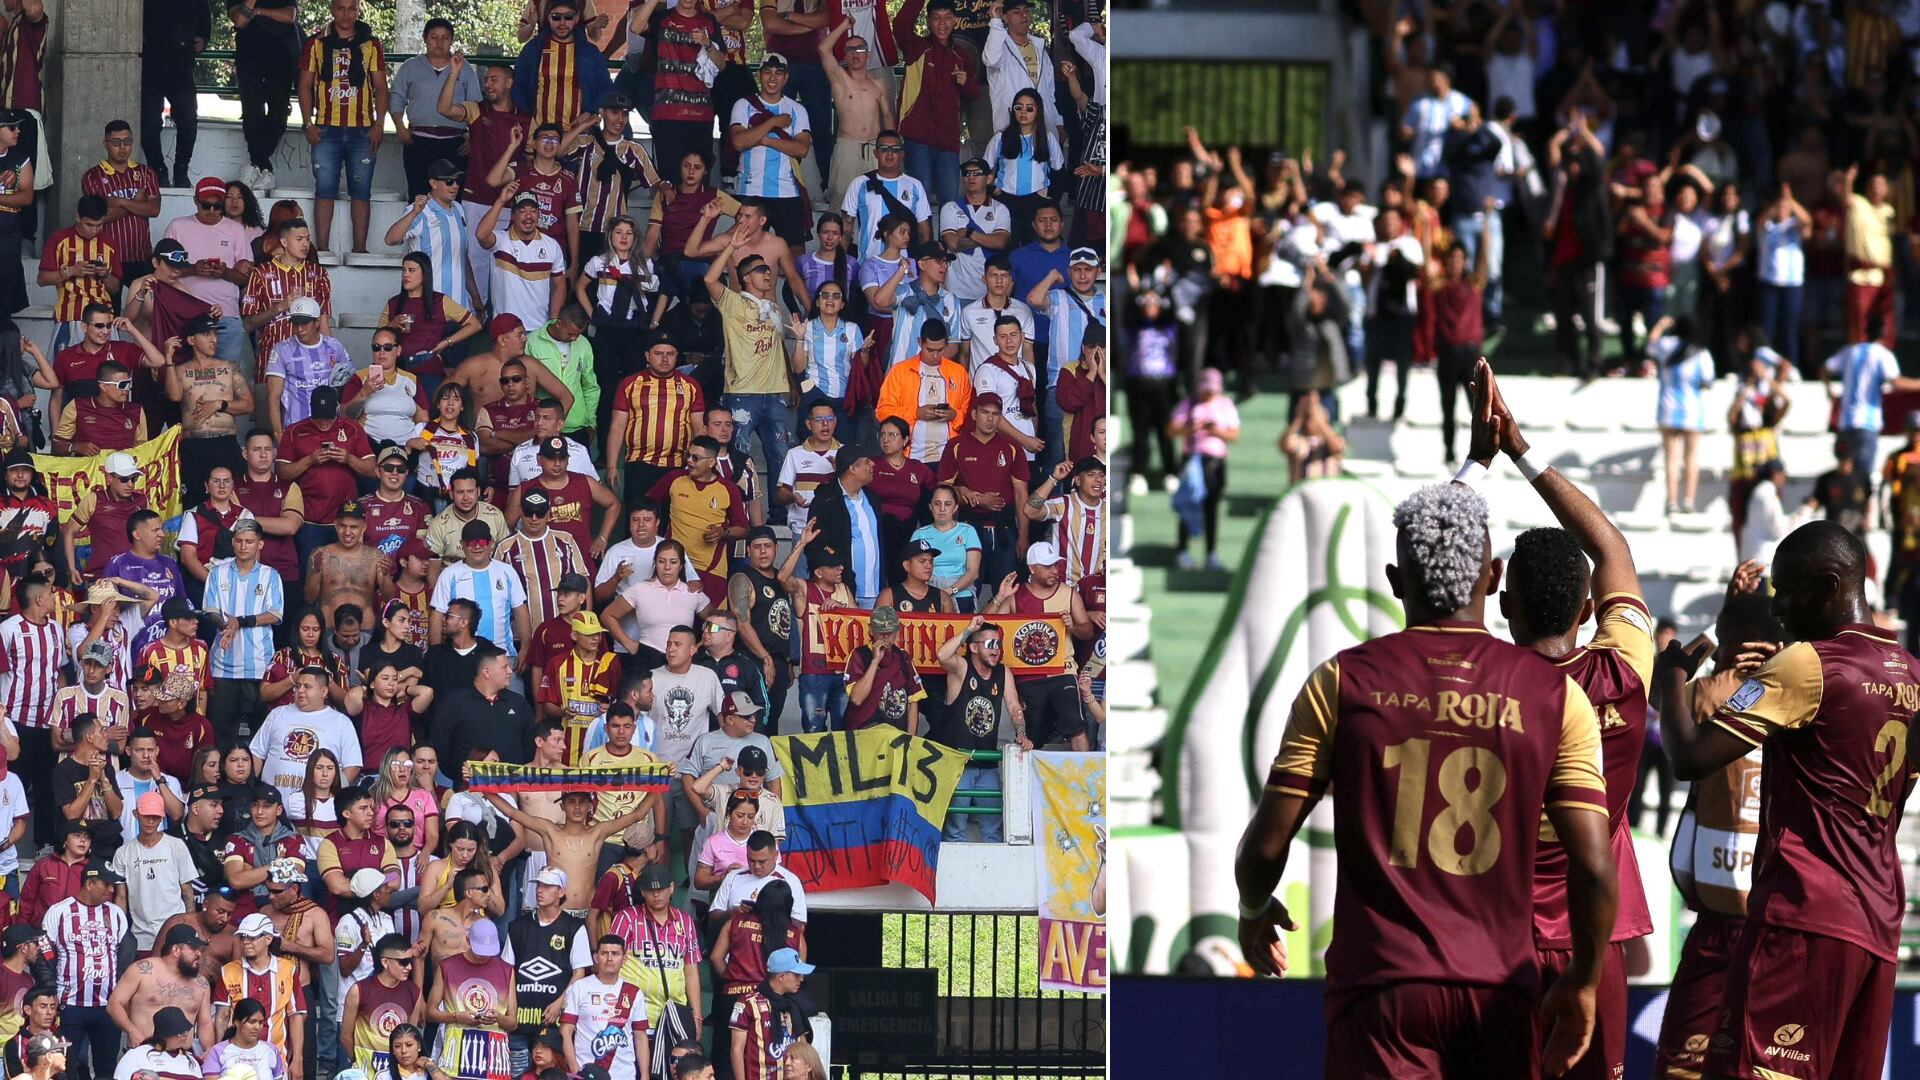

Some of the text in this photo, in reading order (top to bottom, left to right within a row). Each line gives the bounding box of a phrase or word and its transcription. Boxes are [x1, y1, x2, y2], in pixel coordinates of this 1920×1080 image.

[1015, 620, 1056, 642] KOMUNA
[1862, 681, 1920, 712] TAPA ROJ
[1369, 689, 1524, 734] TAPA ROJA
[1866, 720, 1908, 819] 2
[1383, 737, 1508, 877] 18
[516, 981, 557, 994] umbro
[849, 989, 922, 1007] SALIDA DE
[838, 1016, 932, 1034] EMERGENCIA
